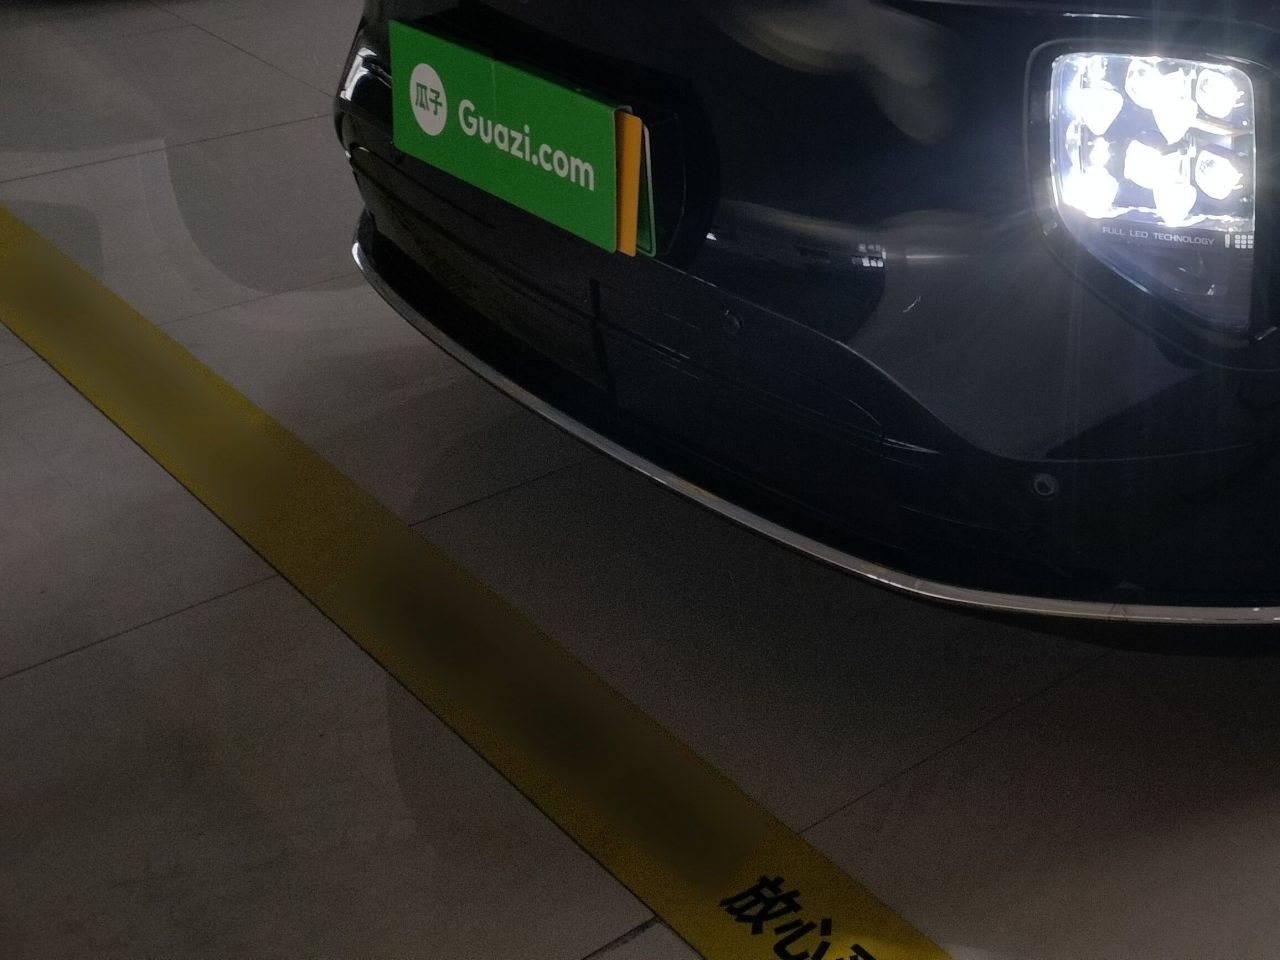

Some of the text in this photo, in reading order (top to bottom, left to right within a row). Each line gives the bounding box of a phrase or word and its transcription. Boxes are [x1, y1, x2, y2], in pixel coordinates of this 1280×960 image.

[415, 82, 443, 116] 瓜子
[458, 99, 594, 191] Guazi.com
[1102, 226, 1215, 246] FULL LED TECHNOLOGY
